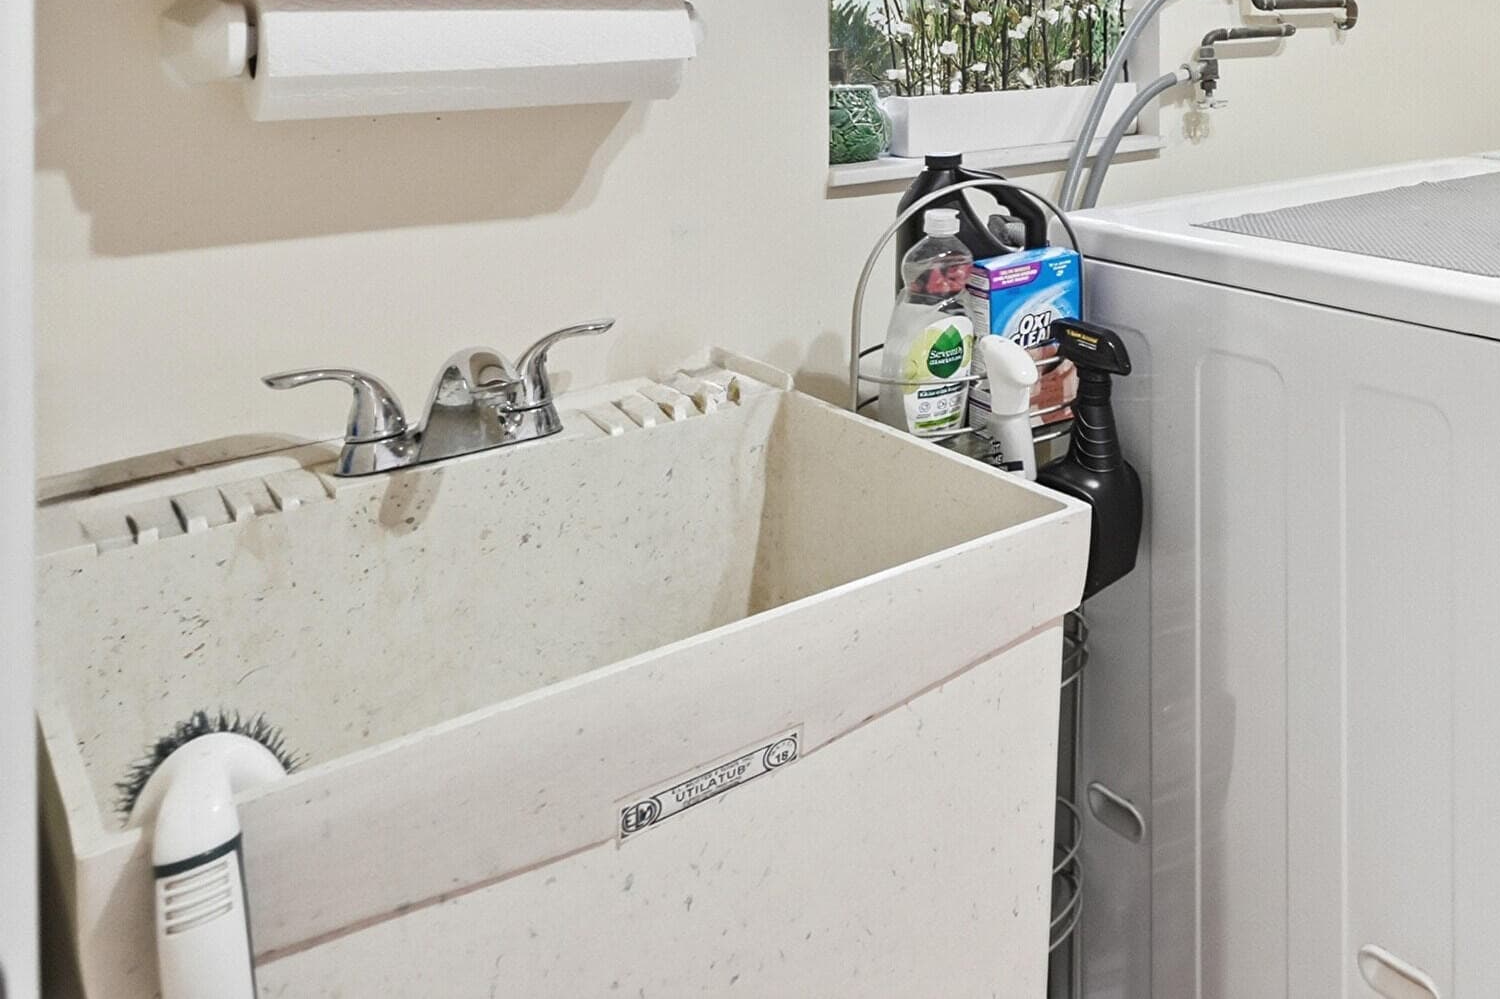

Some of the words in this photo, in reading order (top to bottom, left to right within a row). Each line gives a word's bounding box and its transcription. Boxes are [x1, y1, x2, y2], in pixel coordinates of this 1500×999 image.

[1019, 310, 1052, 335] OXI
[775, 750, 789, 763] 18
[675, 764, 746, 802] UTILATUB
